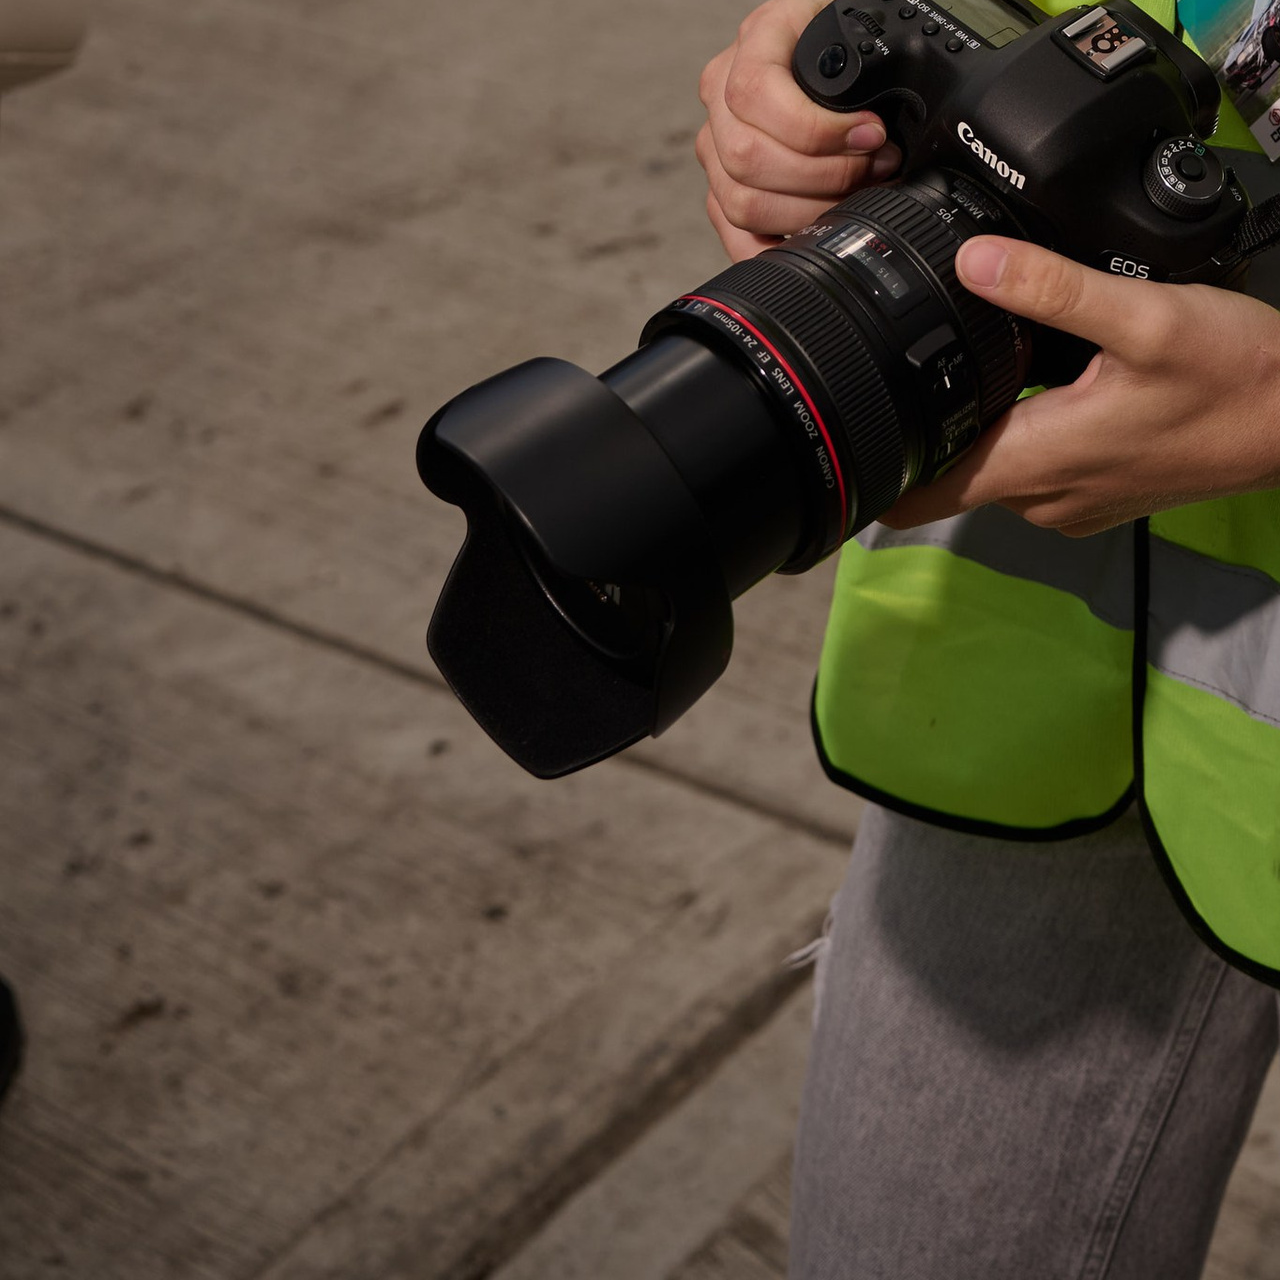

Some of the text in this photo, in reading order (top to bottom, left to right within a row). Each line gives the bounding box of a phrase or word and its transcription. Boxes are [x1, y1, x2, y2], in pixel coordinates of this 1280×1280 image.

[957, 121, 1026, 190] Canon
[936, 208, 954, 224] 105
[951, 190, 985, 219] IMAGE
[1110, 257, 1150, 280] EOS
[713, 310, 758, 348] 24-105mm
[756, 350, 771, 364] EF
[937, 357, 946, 369] AF
[771, 367, 794, 395] LENS
[793, 400, 819, 440] ZOOM
[815, 445, 835, 489] CANON
